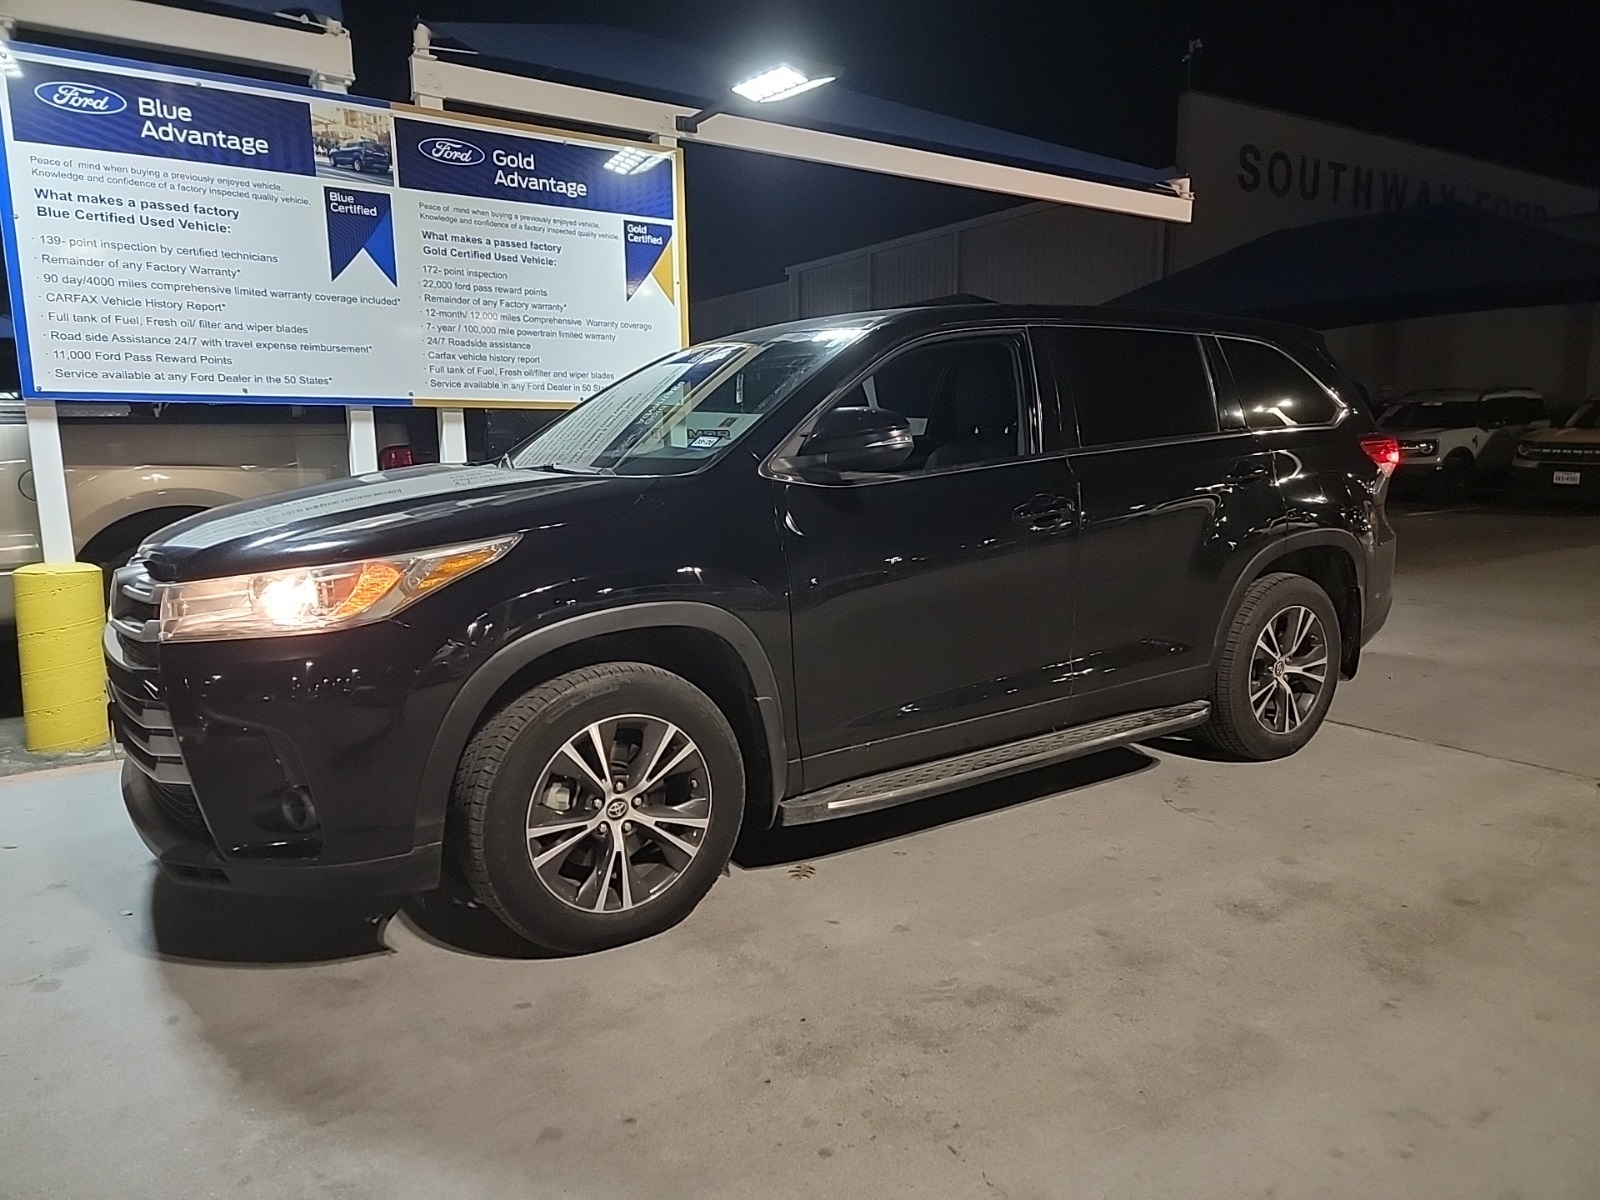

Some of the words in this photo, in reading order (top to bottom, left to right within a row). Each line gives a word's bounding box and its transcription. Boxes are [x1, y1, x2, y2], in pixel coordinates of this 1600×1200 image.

[53, 85, 109, 111] Ford
[138, 97, 192, 122] Blue
[141, 120, 269, 154] Advantage
[431, 141, 472, 163] Ford
[493, 150, 535, 170] Gold
[30, 155, 61, 167] Peace
[63, 160, 73, 168] of
[78, 162, 101, 171] mind
[103, 164, 128, 173] when
[131, 167, 160, 179] buying
[171, 173, 215, 185] previously
[217, 178, 250, 188] enjoyed
[252, 182, 283, 191] vehicle.
[31, 168, 84, 182] Knowledge
[87, 175, 104, 183] and
[107, 177, 156, 188] confidence
[177, 183, 207, 195] factory
[209, 187, 250, 199] inspected
[252, 193, 279, 203] quality
[280, 196, 311, 206] vehicle.
[494, 170, 587, 198] Advantage
[34, 188, 73, 202] What
[77, 194, 123, 207] makes
[128, 200, 136, 208] a
[141, 201, 189, 213] passed
[194, 204, 239, 220] factory
[330, 192, 354, 204] Blue
[331, 202, 377, 216] Certified
[37, 206, 70, 219] Blue
[75, 209, 135, 224] Certified
[140, 215, 175, 228] Used
[178, 219, 231, 234] Vehicle:
[627, 224, 647, 234] Gold
[40, 235, 66, 245] 139-
[69, 238, 98, 248] point
[100, 239, 157, 253] inspection
[160, 244, 173, 256] by
[176, 247, 218, 258] certified
[221, 250, 278, 263] technicians
[421, 230, 448, 242] What
[451, 235, 483, 245] makes
[485, 238, 491, 246] a
[494, 240, 528, 249] passed
[530, 241, 562, 254] factory
[628, 233, 663, 245] Certified
[41, 254, 105, 267] Remainder
[108, 259, 119, 268] of
[122, 262, 143, 272] any
[146, 262, 187, 276] Factory
[423, 246, 447, 256] Gold
[450, 248, 491, 260] Certified
[494, 252, 518, 263] Used
[520, 255, 557, 266] Vehicle:
[423, 265, 442, 274] 172-
[444, 268, 465, 277] point
[467, 268, 508, 280] inspection
[43, 273, 58, 283] 90
[62, 275, 115, 287] day/4000
[118, 279, 148, 289] miles
[151, 282, 232, 295] comprehensive
[234, 286, 268, 297] limited
[270, 291, 312, 302] warranty
[315, 294, 358, 305] coverage
[423, 279, 453, 290] 22,000
[454, 282, 471, 291] ford
[473, 285, 493, 293] pass
[495, 287, 522, 295] reward
[524, 288, 548, 297] points
[46, 292, 98, 304] CARFAX
[101, 296, 142, 307] Vehicle
[145, 298, 183, 312] History
[424, 294, 471, 305] Remainder
[472, 297, 481, 306] of
[483, 300, 498, 309] any
[499, 299, 529, 311] Factory
[48, 312, 69, 322] Full
[73, 314, 98, 323] tank
[101, 314, 112, 324] of
[115, 315, 143, 326] Fuel,
[146, 316, 177, 327] Fresh
[180, 319, 196, 328] oil/
[199, 320, 222, 329] filter
[224, 322, 244, 331] and
[246, 323, 273, 333] wiper
[276, 324, 308, 334] blades
[425, 308, 468, 319] 12-month/
[470, 311, 498, 321] 12,000
[500, 314, 521, 323] miles
[522, 315, 582, 326] Comprehensive
[586, 319, 619, 330] Warranty
[620, 322, 652, 332] coverage
[51, 331, 82, 341] Road
[85, 333, 109, 342] side
[111, 334, 171, 345] Assistance
[174, 337, 197, 346] 24/7
[200, 338, 222, 347] with
[224, 339, 253, 348] travel
[256, 342, 297, 351] expense
[426, 322, 435, 331] 7-
[437, 325, 456, 333] year
[458, 324, 461, 332] /
[464, 325, 497, 334] 100,000
[517, 329, 557, 338] powertrain
[558, 330, 583, 339] limited
[584, 333, 616, 343] warranty
[427, 336, 446, 345] 24/7
[448, 338, 487, 348] Roadside
[489, 342, 531, 350] assistance
[53, 350, 92, 360] 11,000
[95, 351, 121, 361] Ford
[124, 352, 153, 362] Pass
[155, 354, 197, 364] Reward
[200, 356, 233, 365] Points
[428, 351, 456, 360] Carfax
[458, 353, 487, 362] vehicle
[489, 354, 516, 364] history
[517, 357, 541, 365] report
[55, 368, 98, 379] Service
[102, 371, 151, 380] available
[154, 372, 165, 381] at
[168, 374, 188, 383] any
[190, 372, 215, 382] Ford
[218, 374, 251, 383] Dealer
[254, 375, 263, 383] in
[266, 375, 281, 384] the
[284, 376, 296, 384] 50
[429, 365, 445, 374] Full
[447, 366, 465, 374] tank
[467, 367, 475, 375] of
[477, 367, 498, 376] Fuel,
[499, 368, 522, 376] Fresh
[524, 369, 551, 378] oil/filter
[569, 372, 589, 380] wiper
